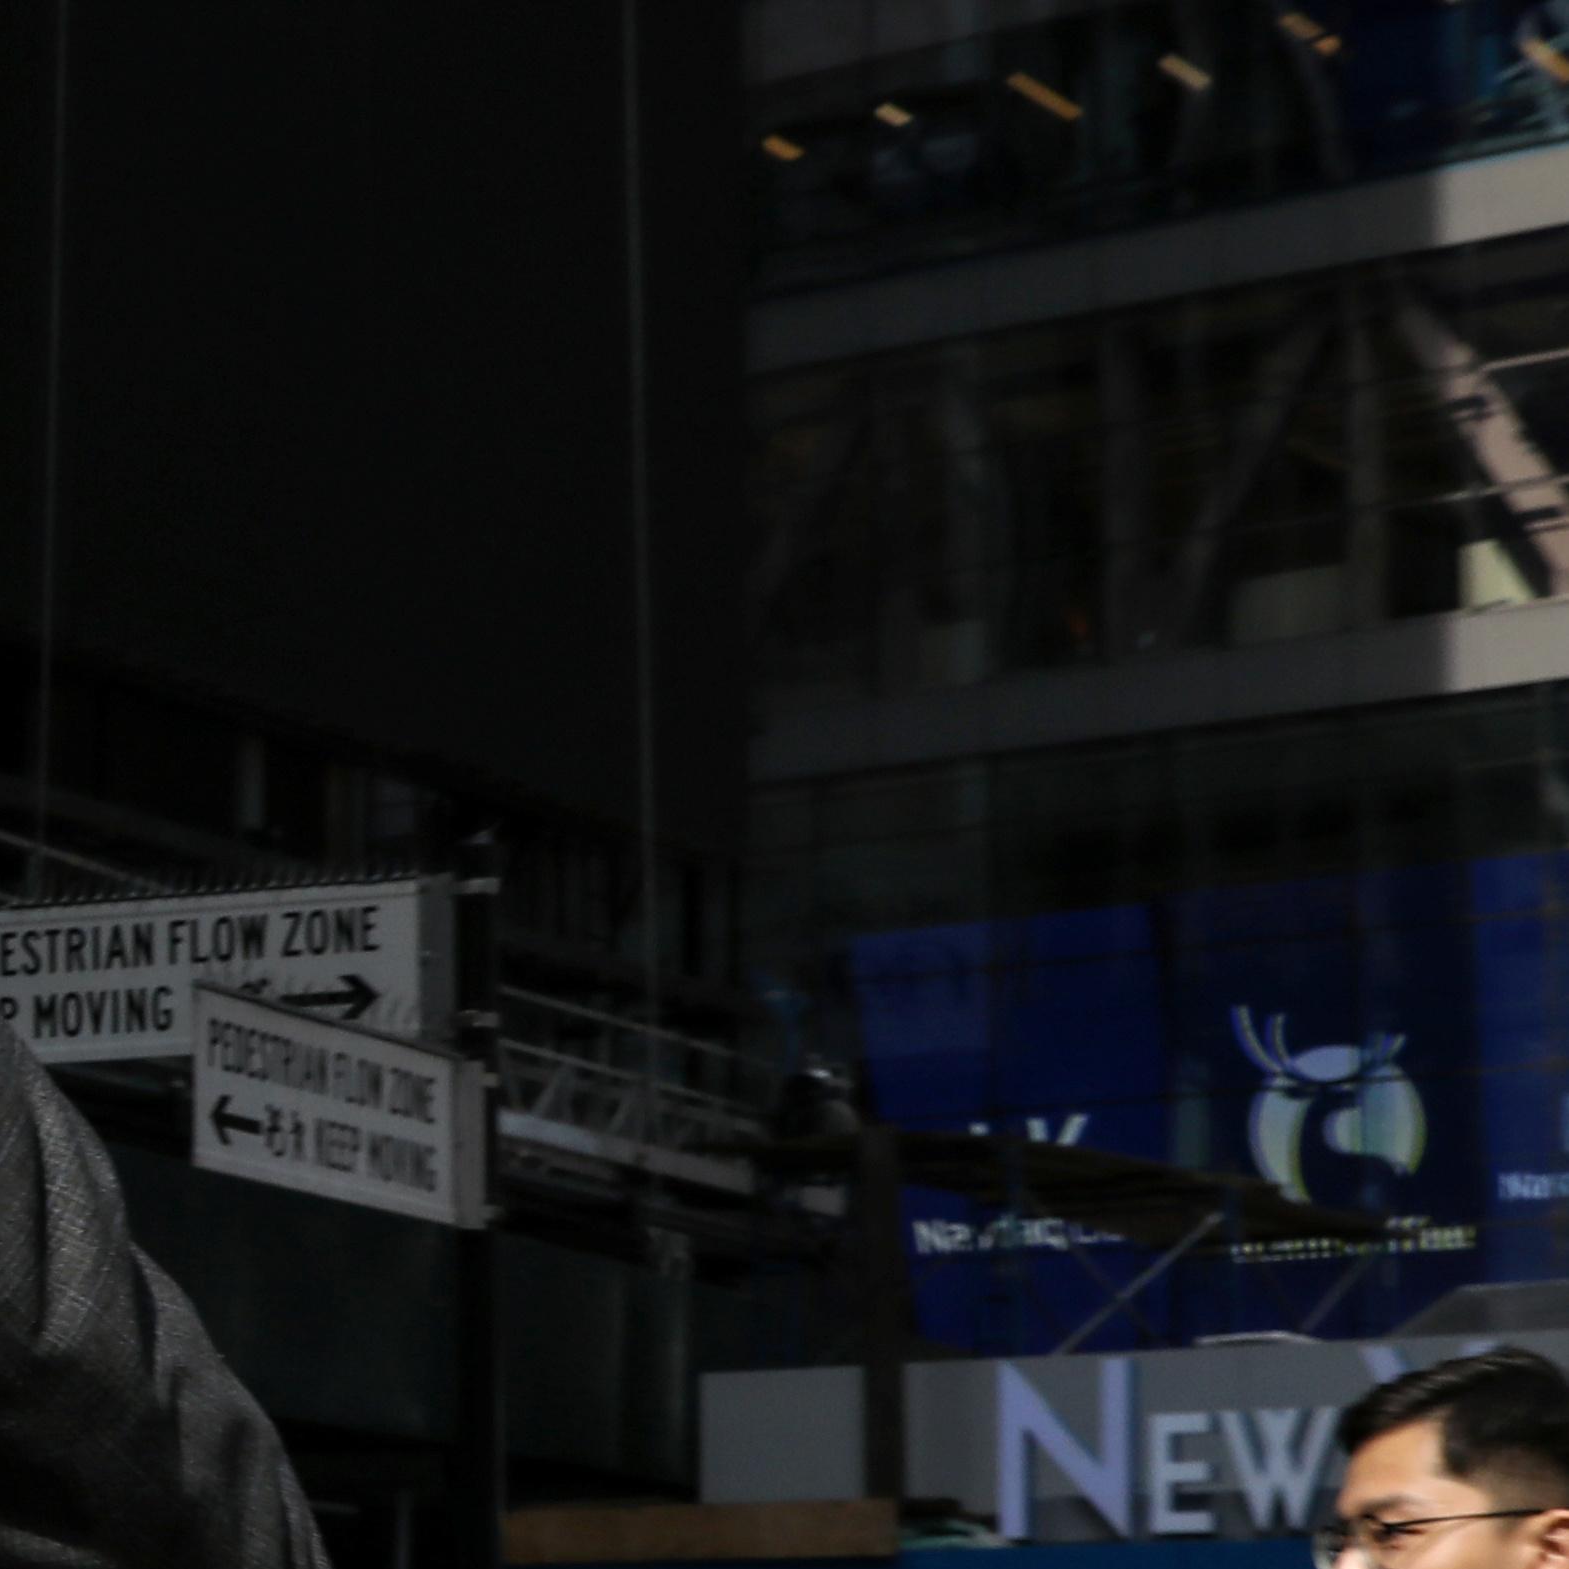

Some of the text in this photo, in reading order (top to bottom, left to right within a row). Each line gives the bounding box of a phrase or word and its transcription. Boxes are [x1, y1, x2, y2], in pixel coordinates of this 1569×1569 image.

[168, 912, 266, 966] FLOW
[282, 906, 381, 958] ZONE
[32, 986, 174, 1039] MOVING
[208, 1018, 331, 1096] PEDESTRIAN
[389, 1066, 436, 1125] ZONE
[315, 1117, 438, 1193] KEEP MOVING
